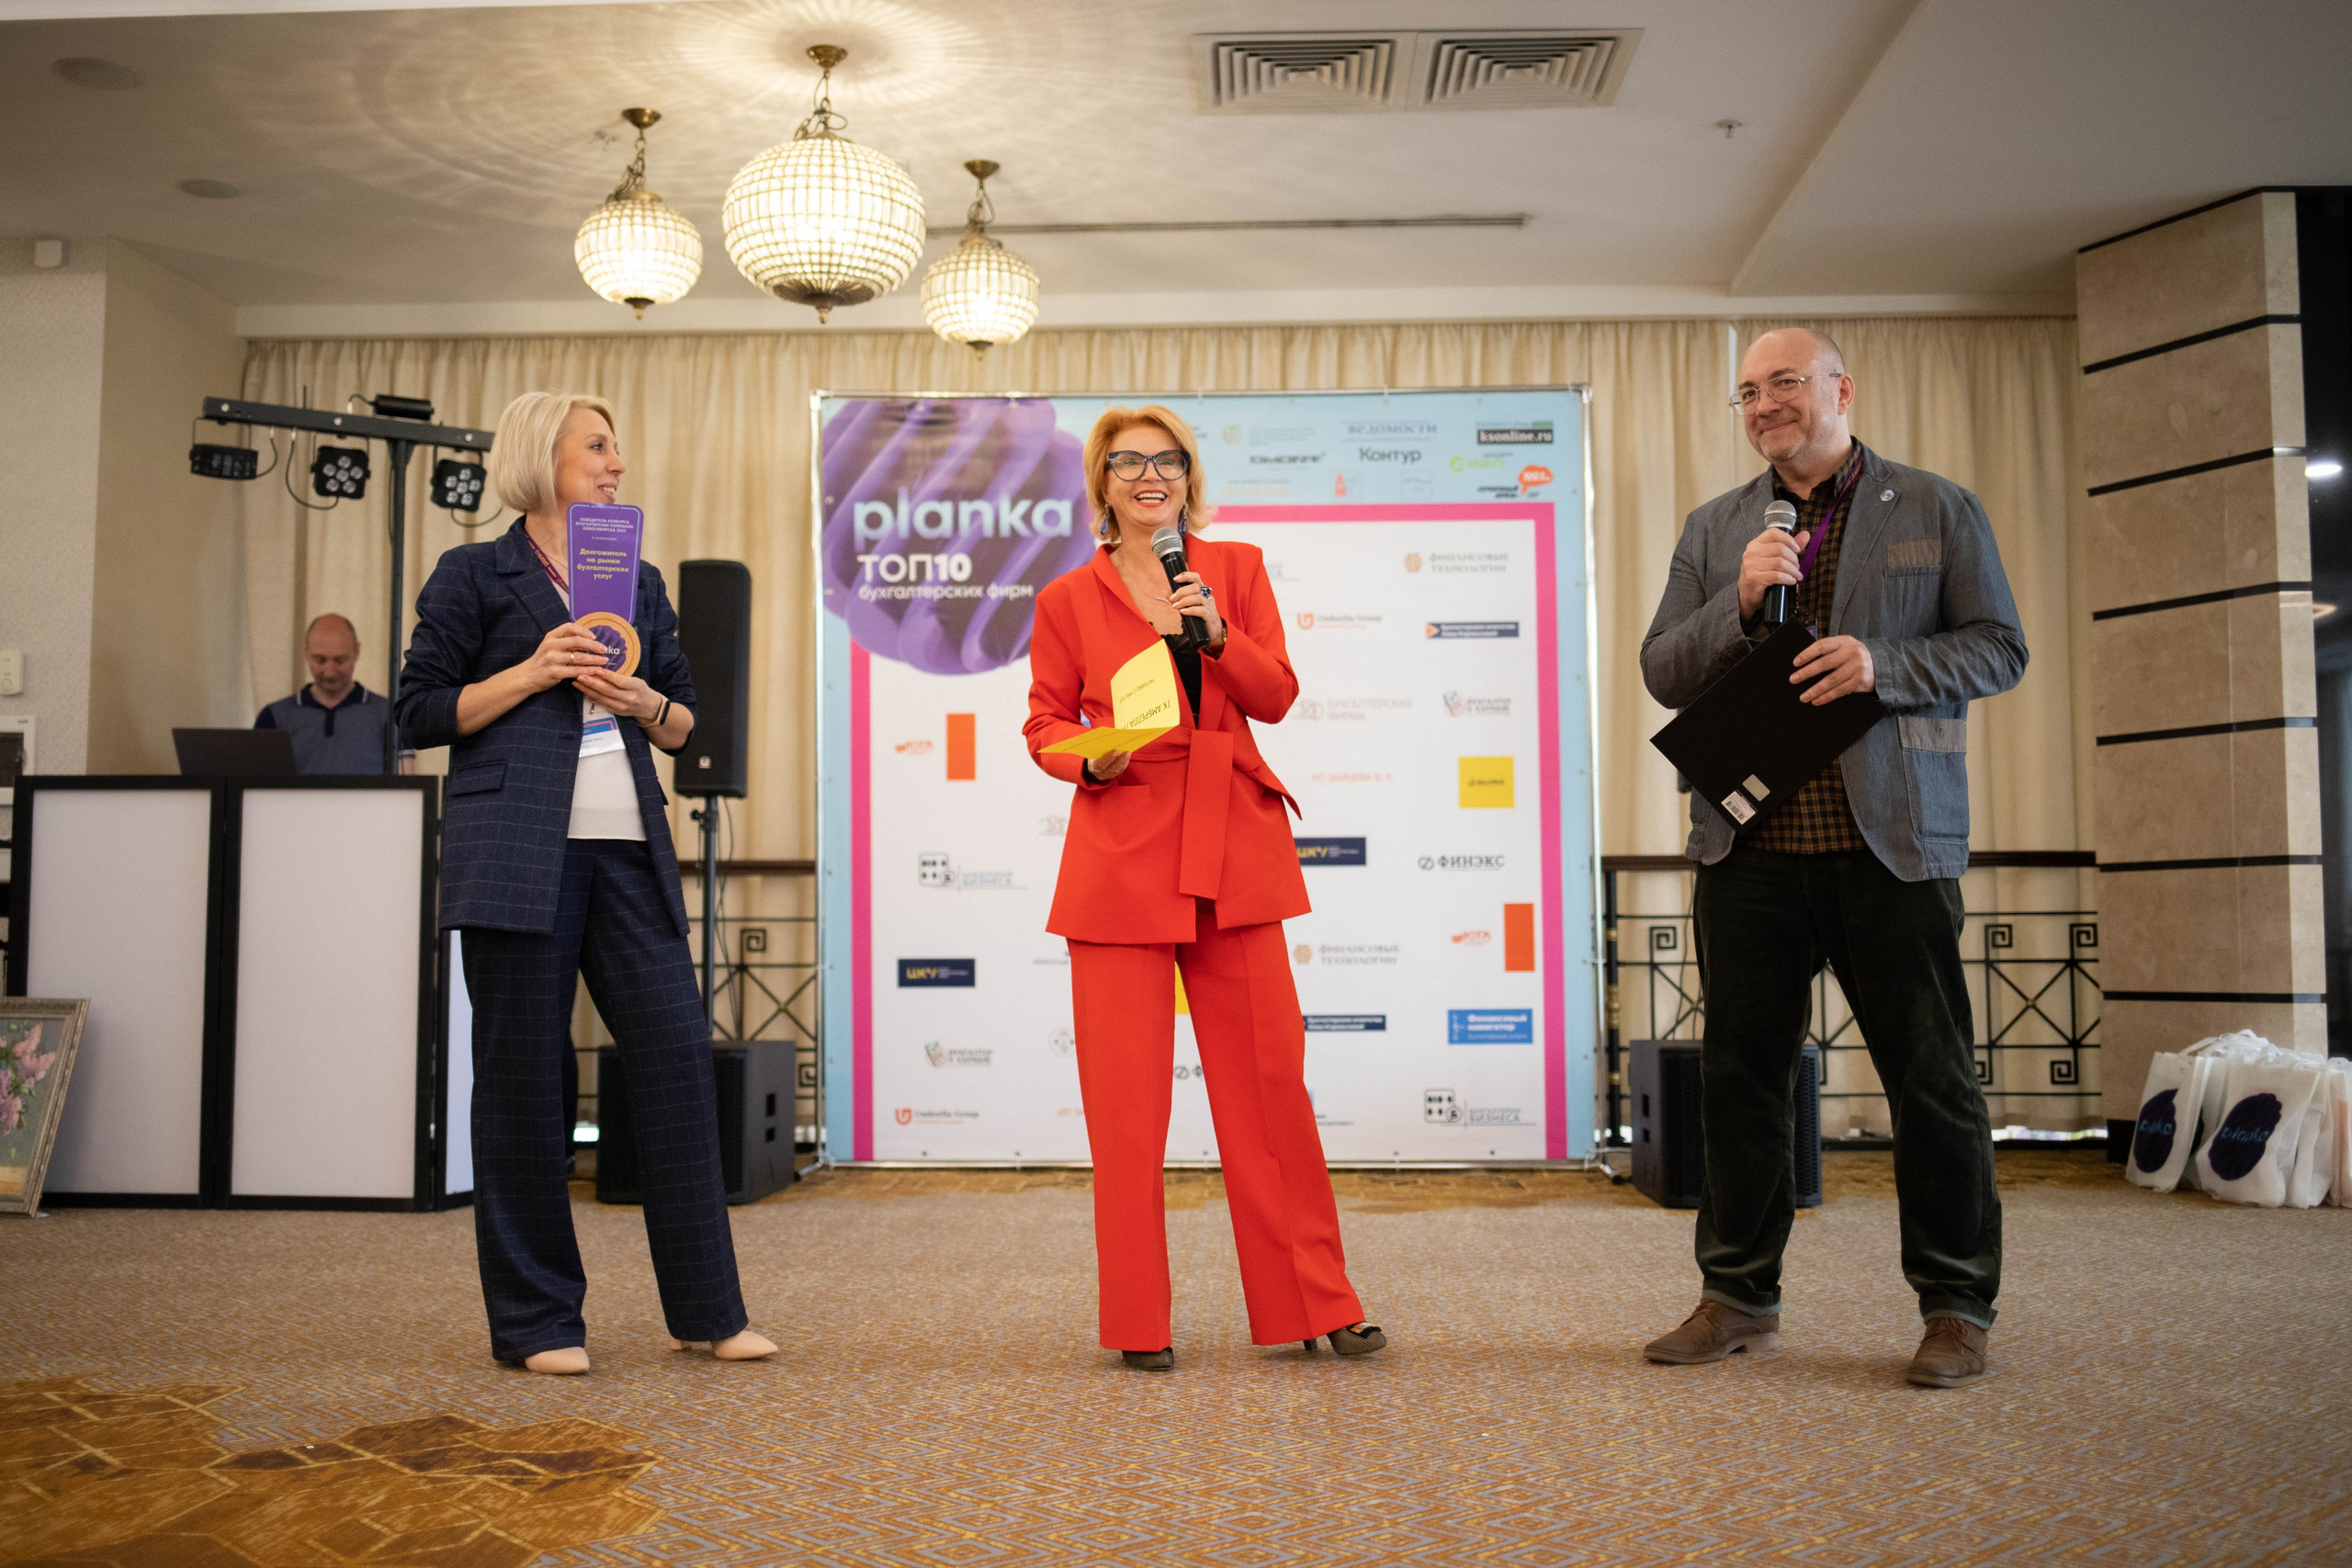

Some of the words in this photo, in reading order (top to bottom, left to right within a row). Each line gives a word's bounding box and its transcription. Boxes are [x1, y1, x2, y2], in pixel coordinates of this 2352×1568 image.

[1479, 430, 1552, 442] ksonline.ru
[1359, 446, 1421, 465] Контур
[854, 487, 1072, 552] planka
[580, 548, 628, 557] Долгожитель
[577, 563, 629, 572] бухгалтерских
[858, 583, 983, 602] бухгалтерских
[987, 583, 1035, 601] фирм
[1162, 700, 1170, 710] ГК
[1129, 704, 1161, 728] АМБРЕЛЛА
[1438, 854, 1506, 868] ФИНЭКС
